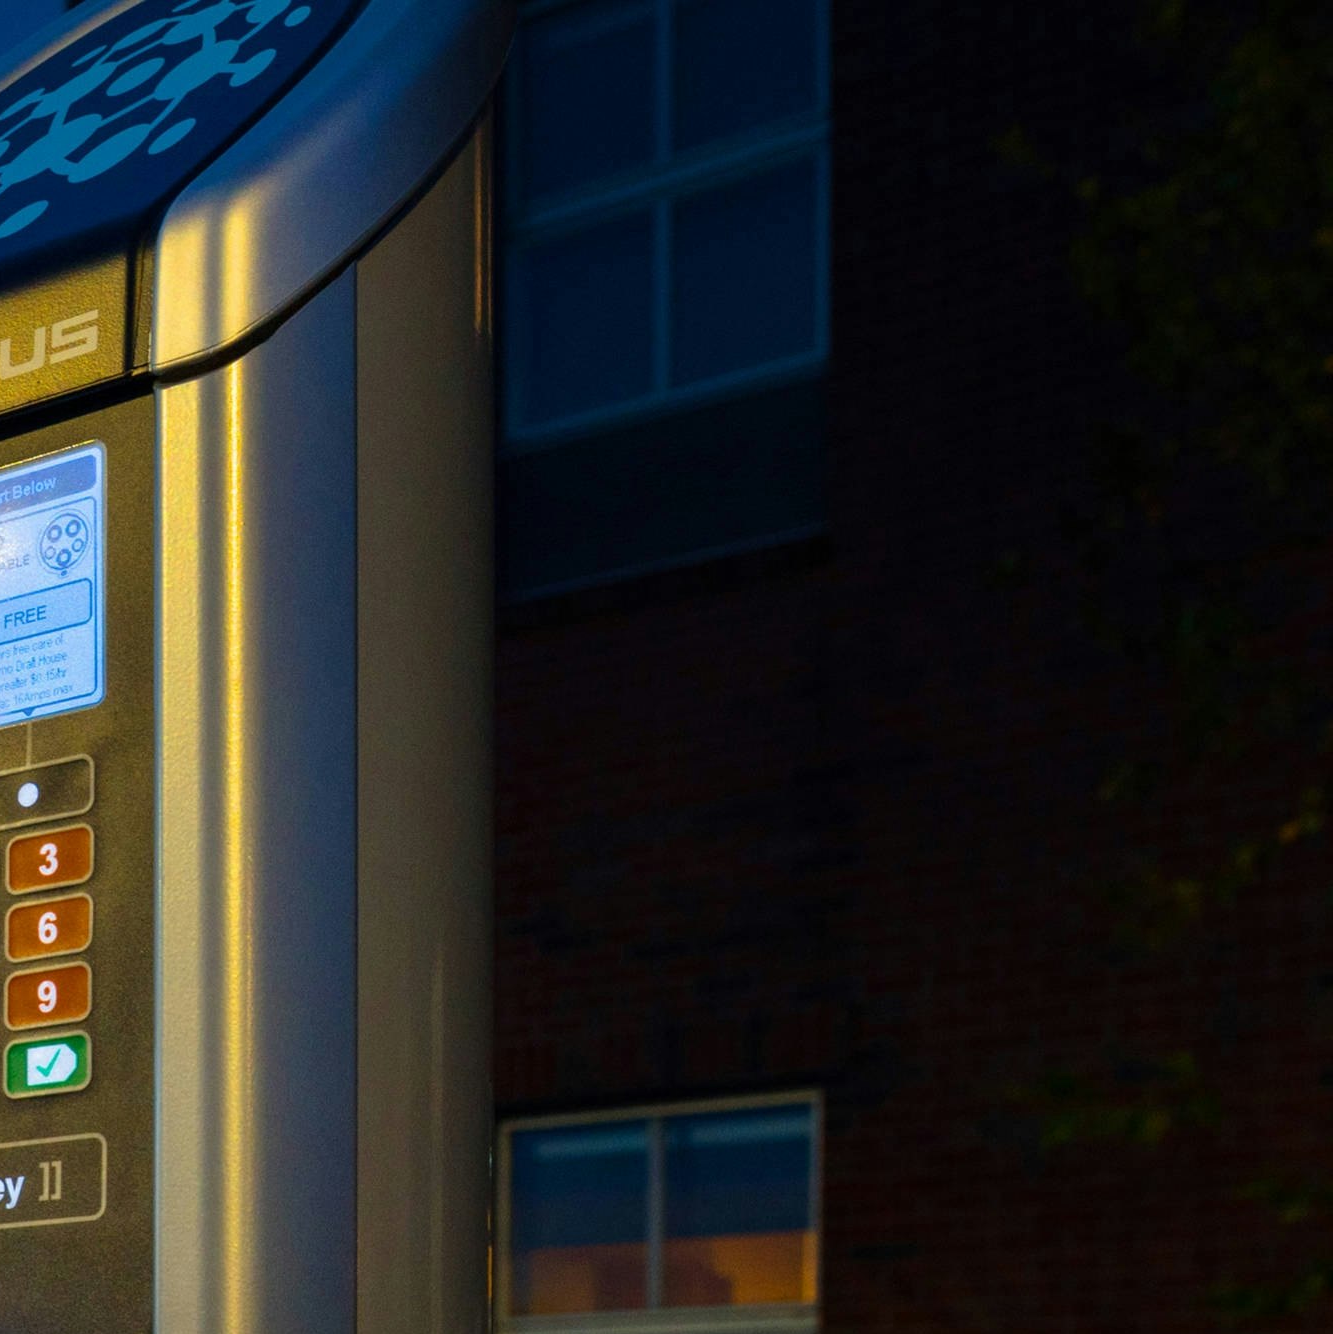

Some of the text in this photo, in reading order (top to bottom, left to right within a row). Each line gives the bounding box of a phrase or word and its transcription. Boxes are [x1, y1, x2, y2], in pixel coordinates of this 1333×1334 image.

[12, 475, 57, 499] Below
[3, 605, 47, 629] FREE
[38, 842, 59, 876] 3
[37, 911, 58, 944] 6
[37, 980, 57, 1013] 9
